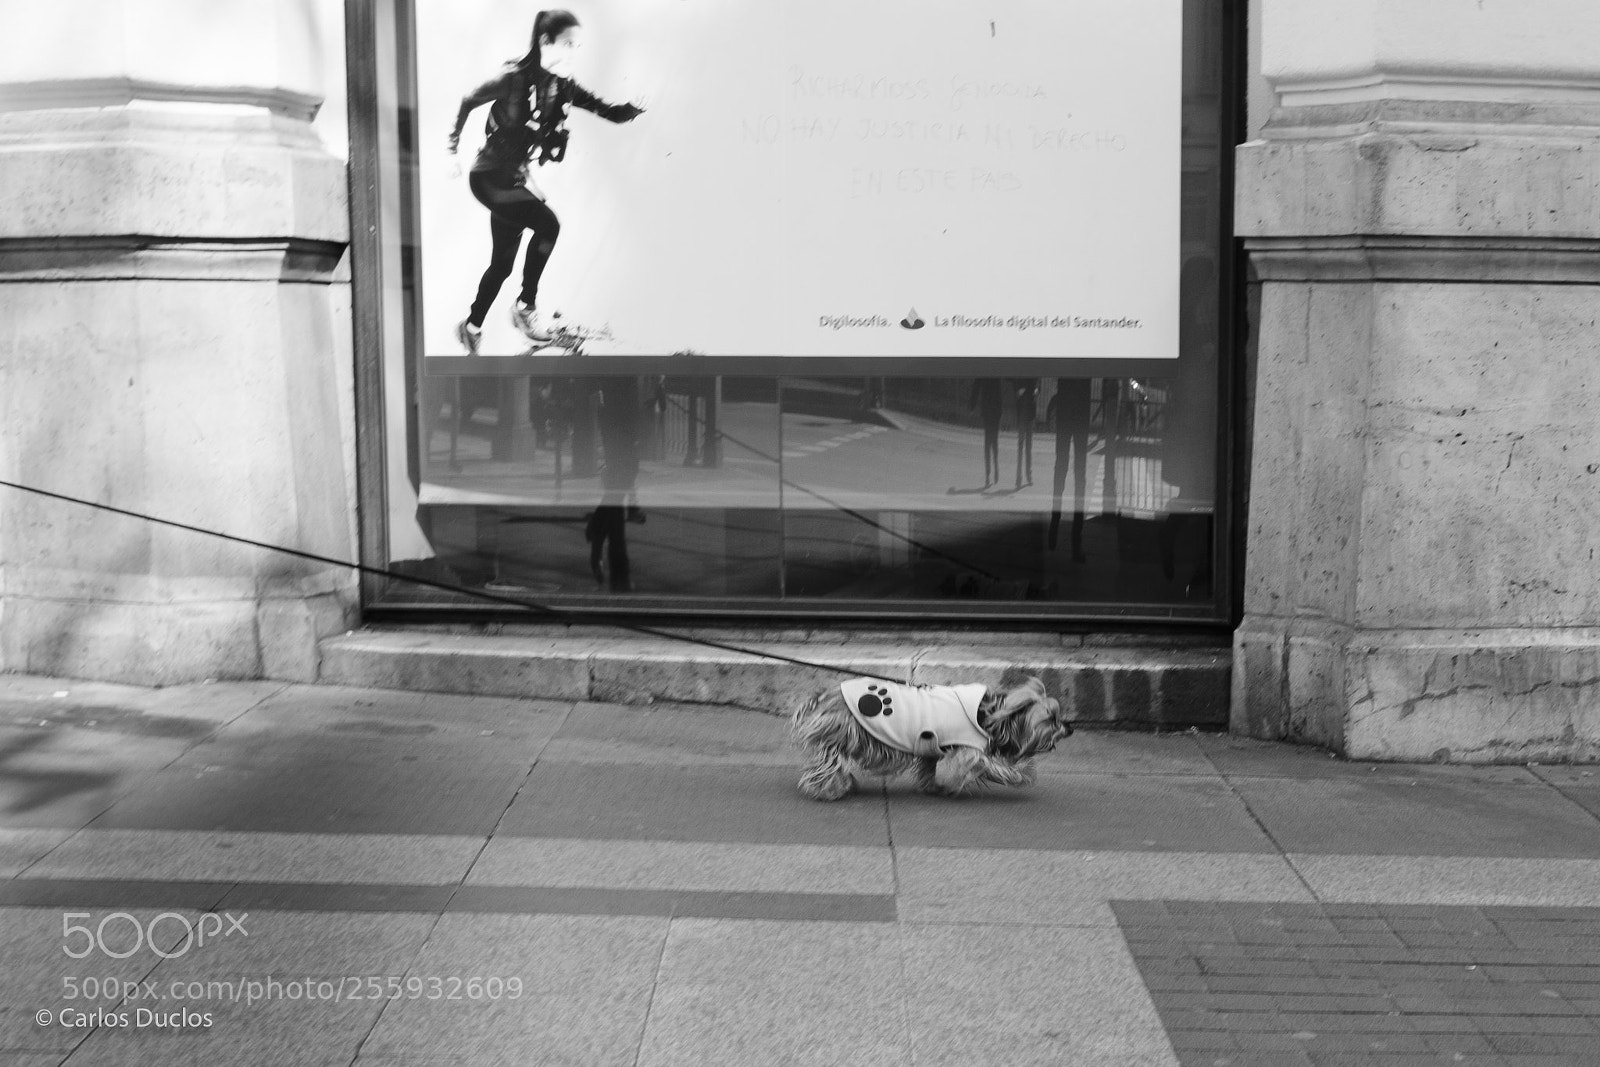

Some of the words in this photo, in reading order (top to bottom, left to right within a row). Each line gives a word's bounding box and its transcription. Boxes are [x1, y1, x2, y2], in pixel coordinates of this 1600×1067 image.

[742, 113, 781, 144] NO
[791, 117, 841, 142] HAY
[896, 167, 959, 193] ESTE
[934, 315, 949, 328] La
[1006, 314, 1048, 330] digital
[1050, 314, 1071, 328] del
[1073, 315, 1143, 329] Santander.
